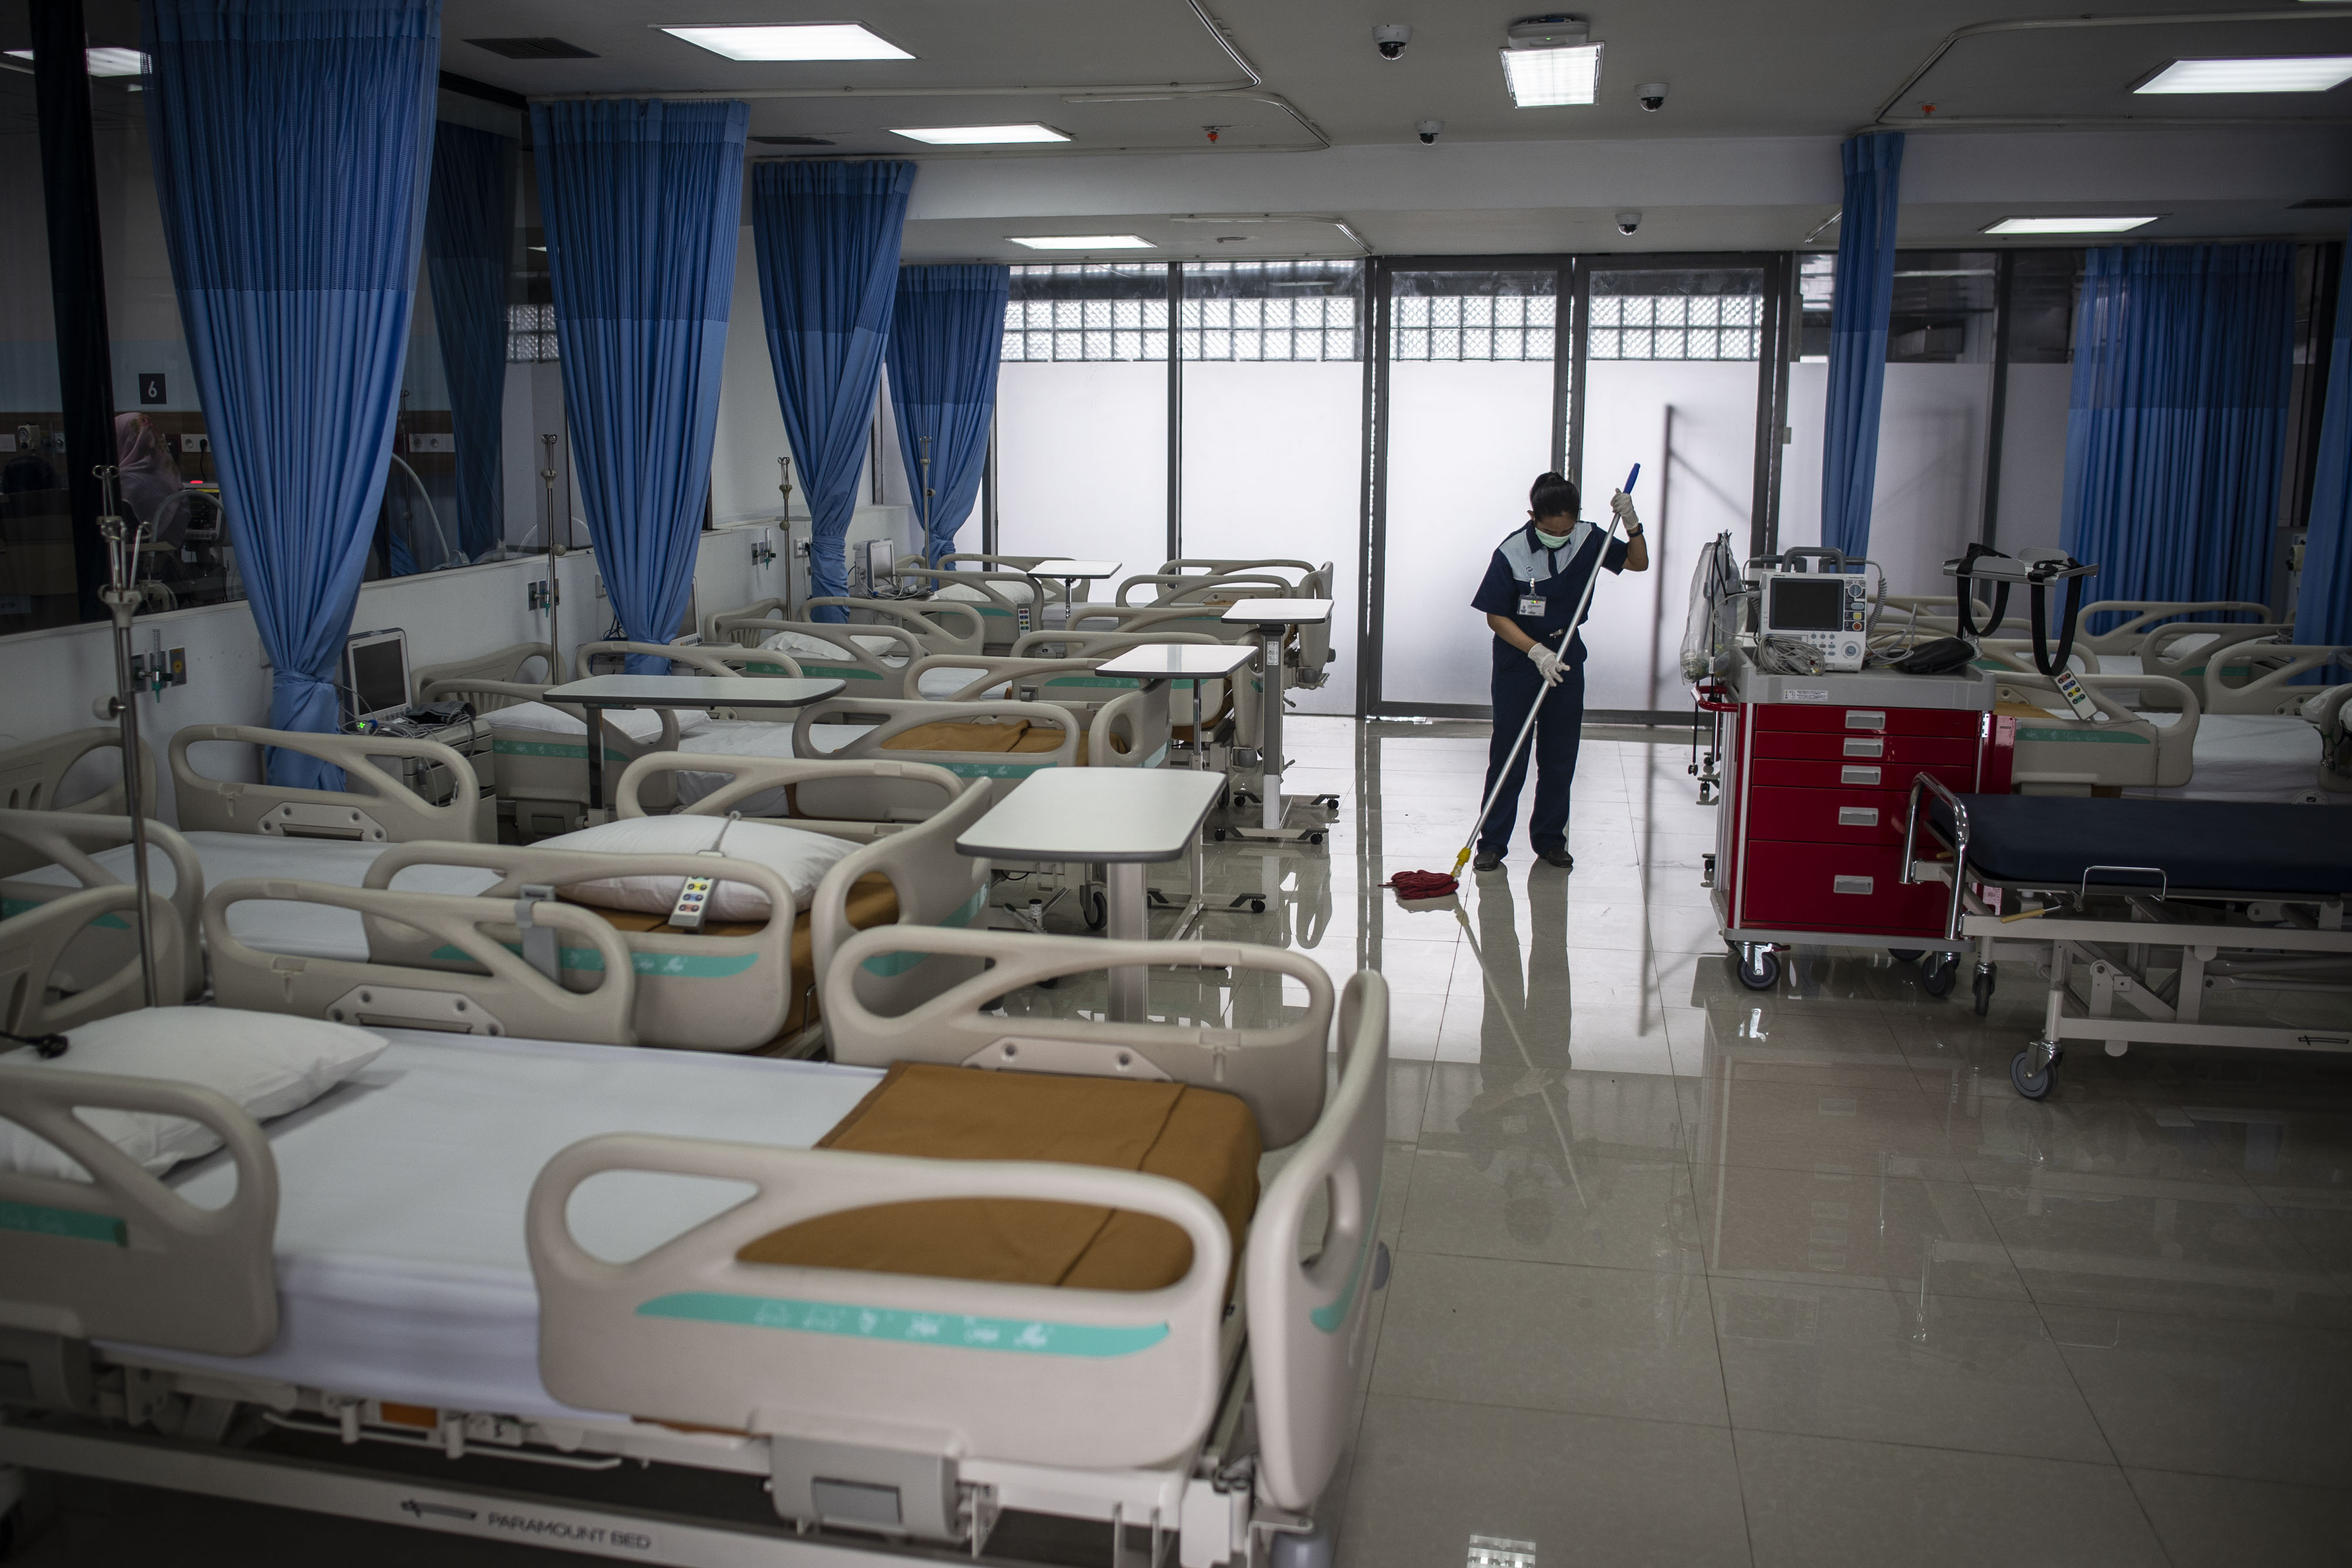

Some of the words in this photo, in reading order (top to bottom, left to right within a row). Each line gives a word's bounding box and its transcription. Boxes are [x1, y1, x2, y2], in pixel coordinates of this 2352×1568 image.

[148, 381, 157, 398] 6
[487, 1511, 606, 1543] PARAMOUNT
[610, 1529, 652, 1550] BED
